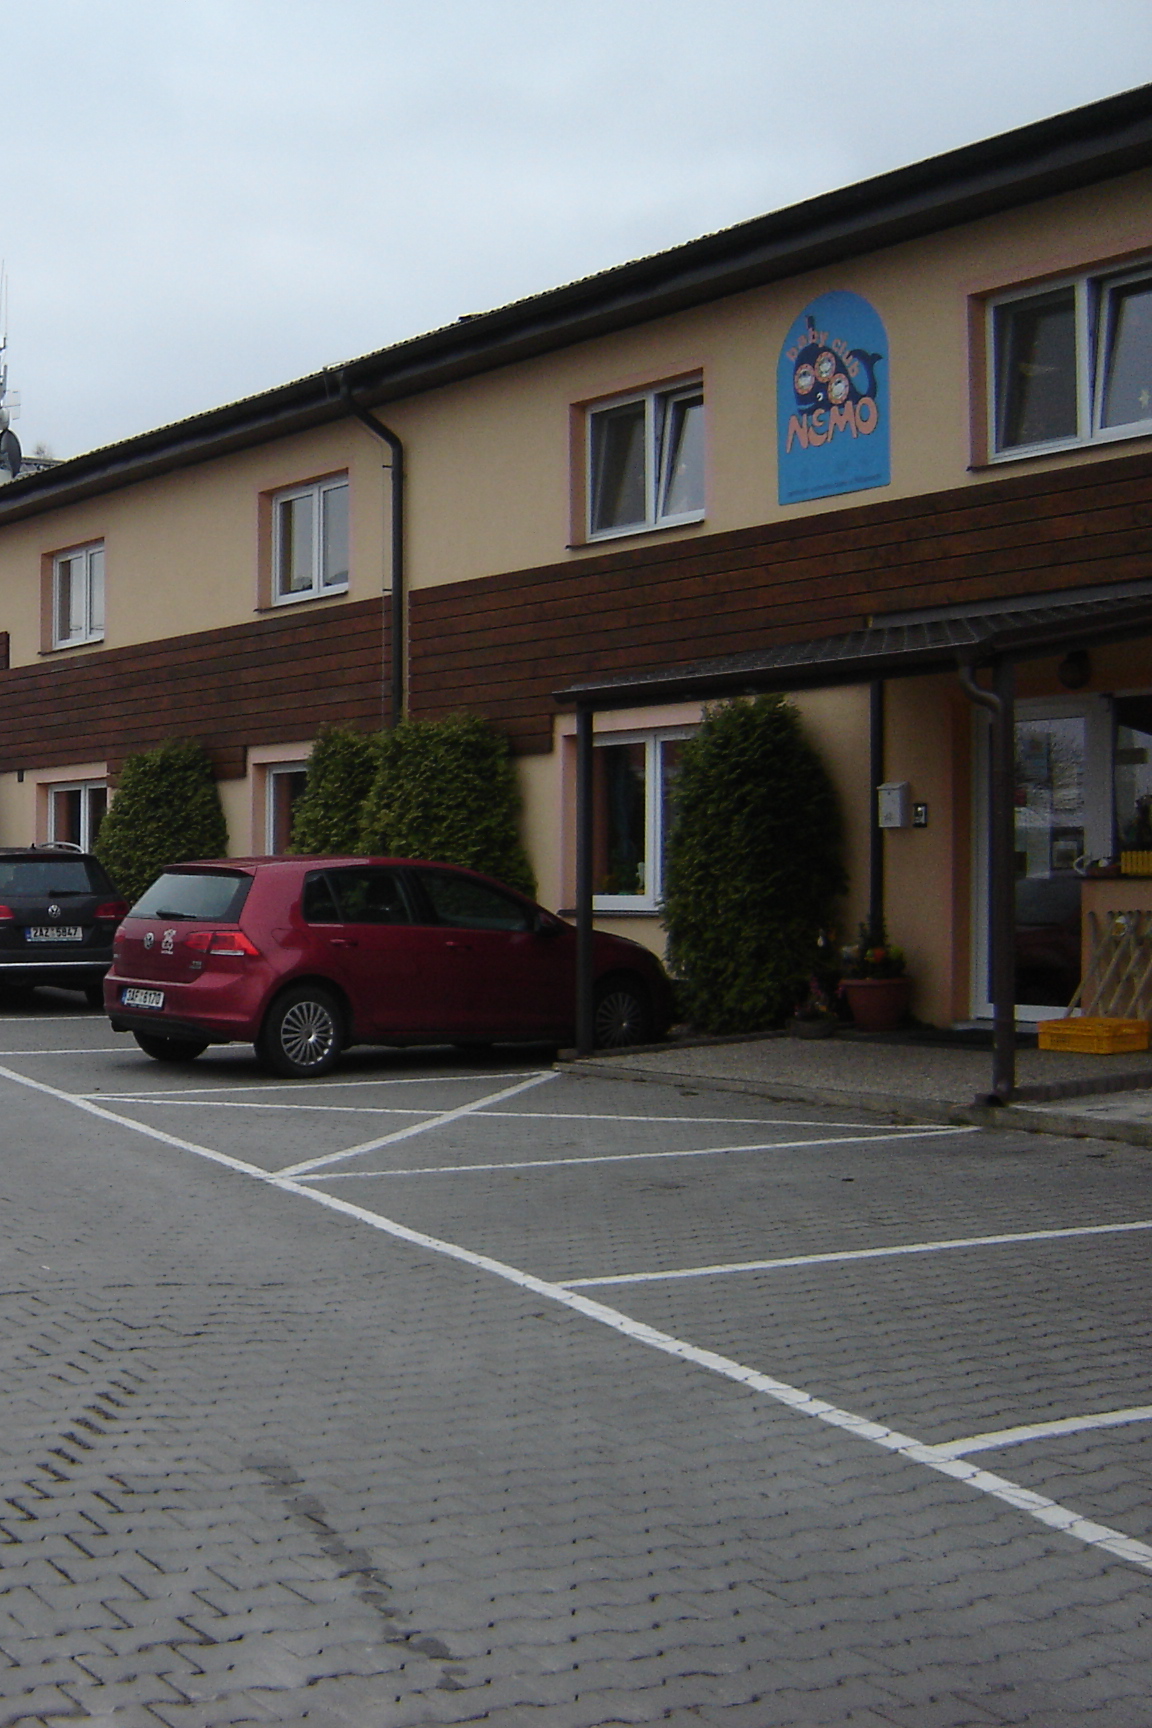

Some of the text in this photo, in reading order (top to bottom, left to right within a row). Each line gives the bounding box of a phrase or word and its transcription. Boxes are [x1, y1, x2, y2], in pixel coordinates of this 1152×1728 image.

[786, 327, 859, 377] baby club
[787, 397, 878, 453] NEMO
